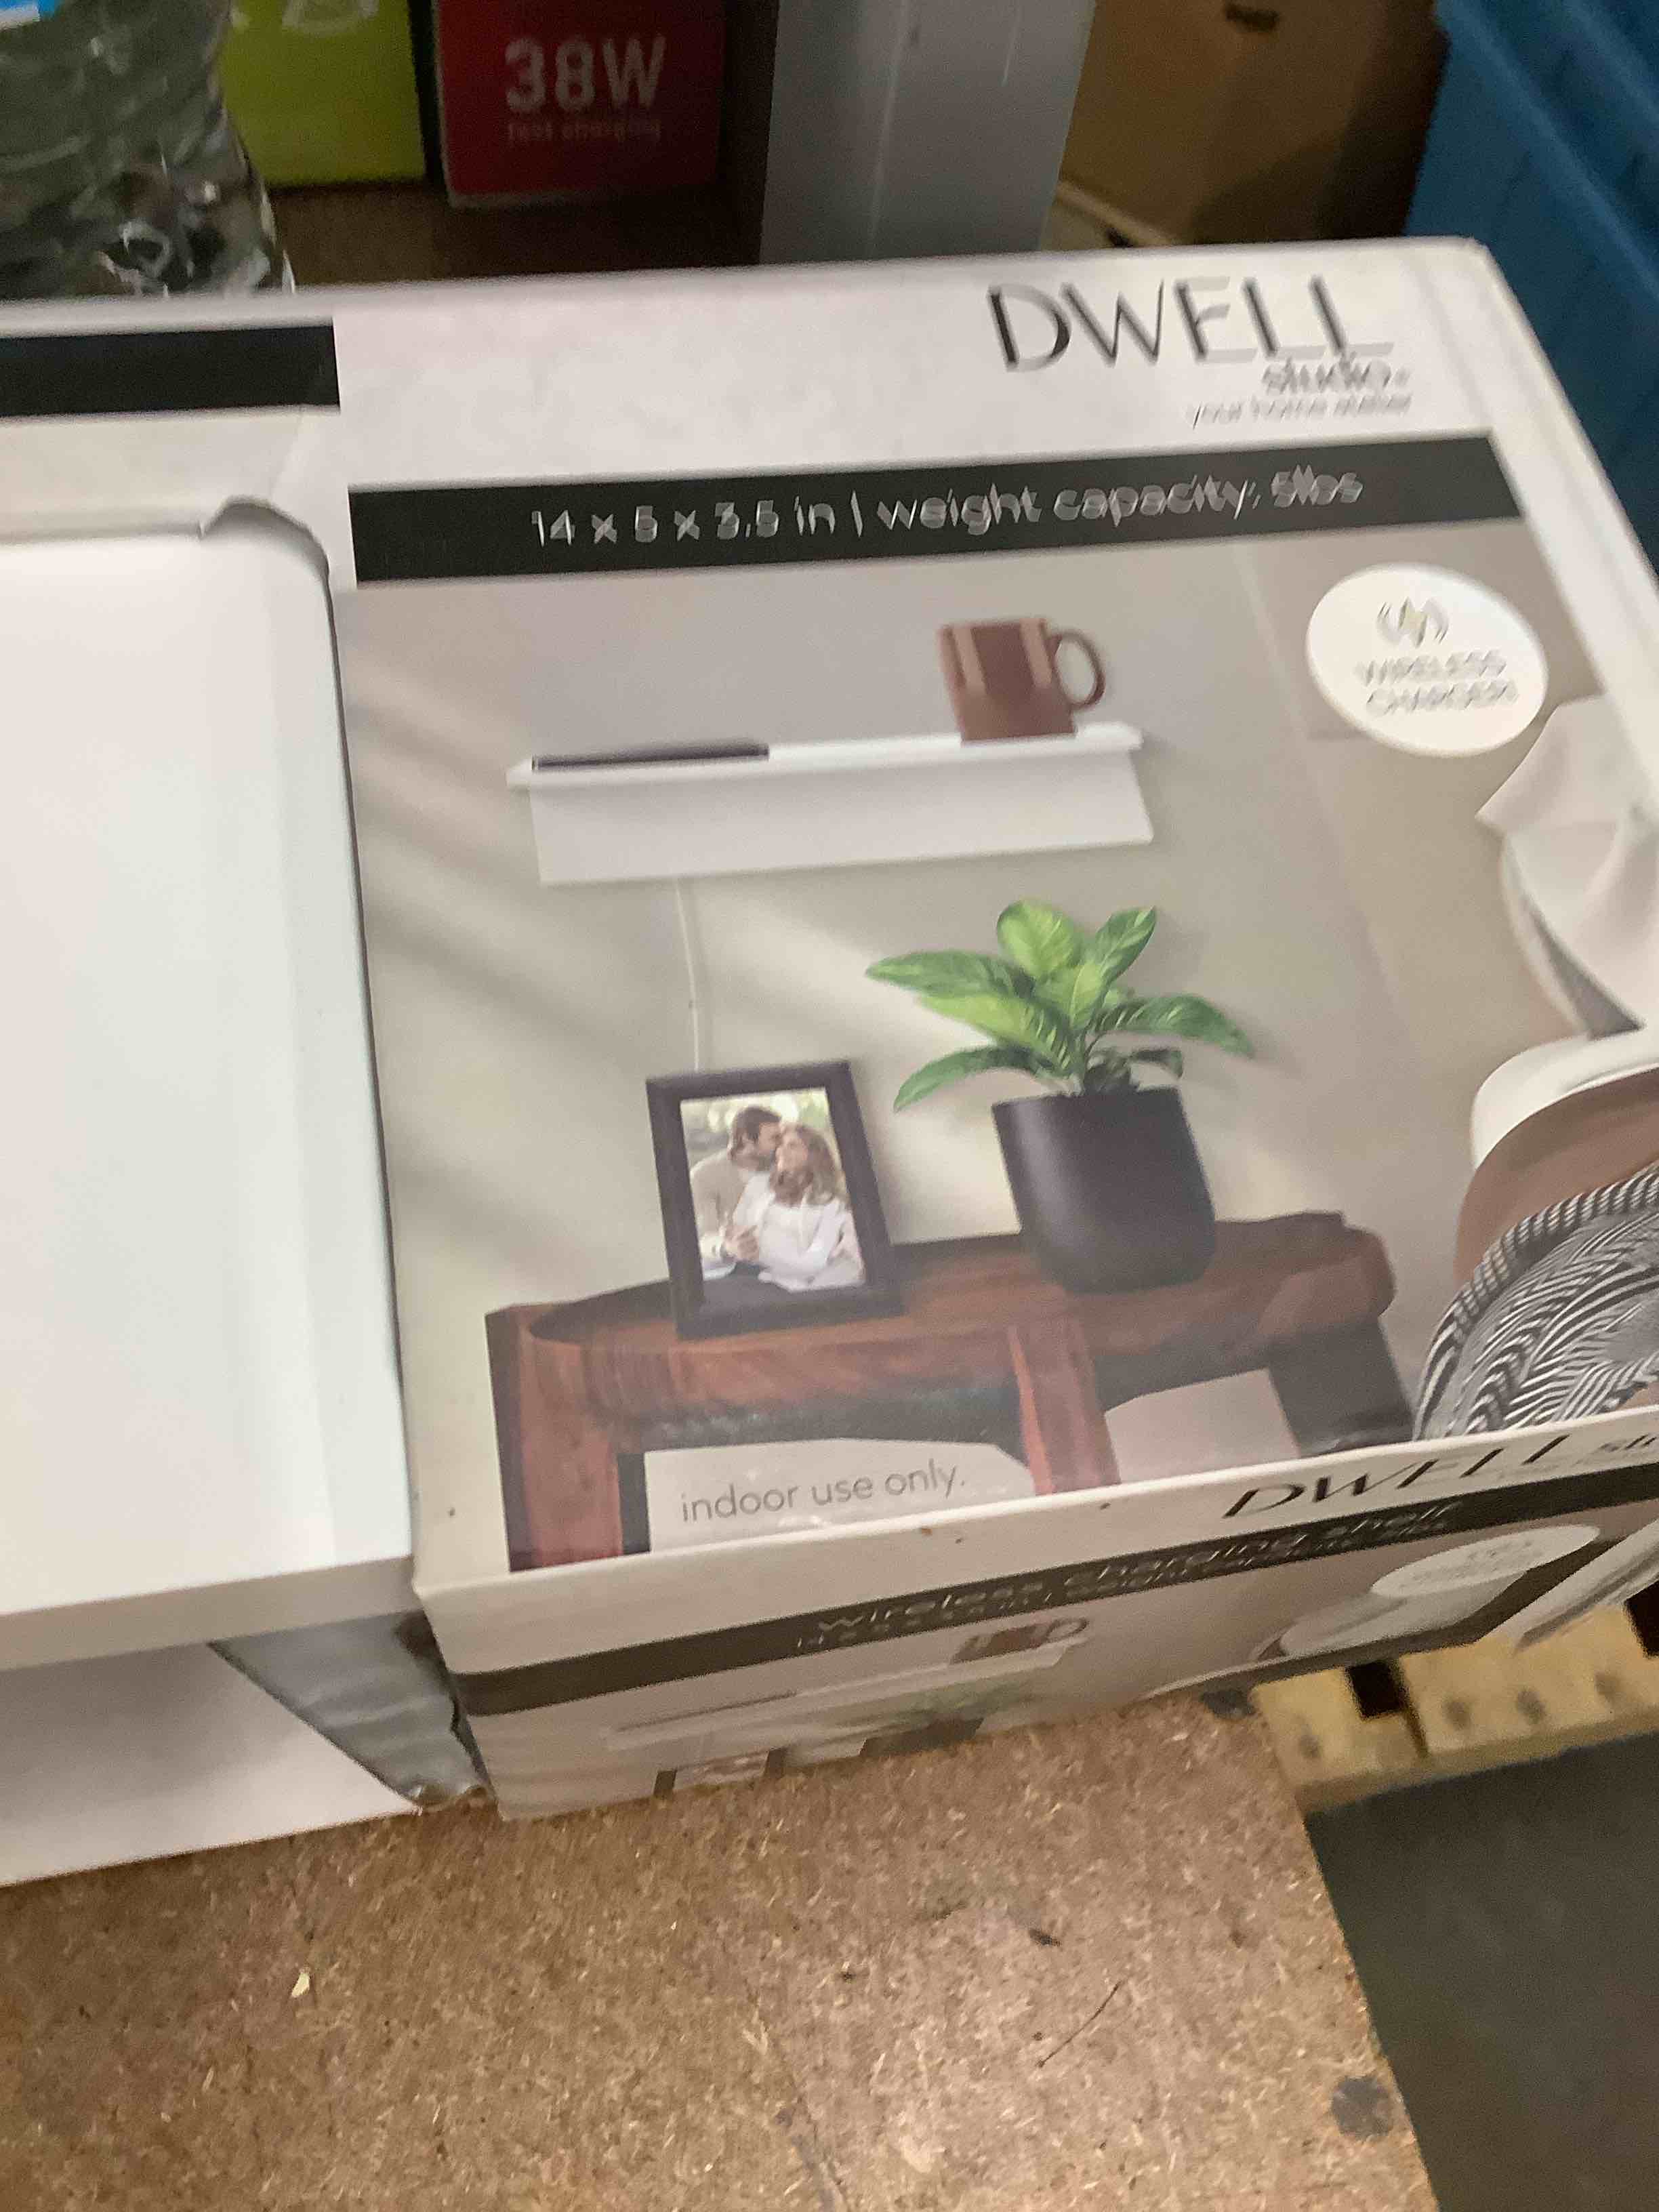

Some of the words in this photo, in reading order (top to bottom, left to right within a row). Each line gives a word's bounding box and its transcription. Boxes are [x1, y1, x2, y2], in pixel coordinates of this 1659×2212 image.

[504, 34, 666, 113] 38W
[987, 274, 1394, 372] DWELL
[532, 510, 576, 546] 14
[591, 513, 617, 544] x
[674, 509, 701, 541] x
[715, 501, 780, 539] 3.5
[794, 495, 836, 535] in
[876, 483, 1042, 535] weight
[1354, 649, 1508, 685] WIRELESS
[681, 1484, 797, 1522] indoor
[813, 1475, 874, 1506] use
[884, 1458, 965, 1498] only.
[1223, 1433, 1572, 1518] DWELL
